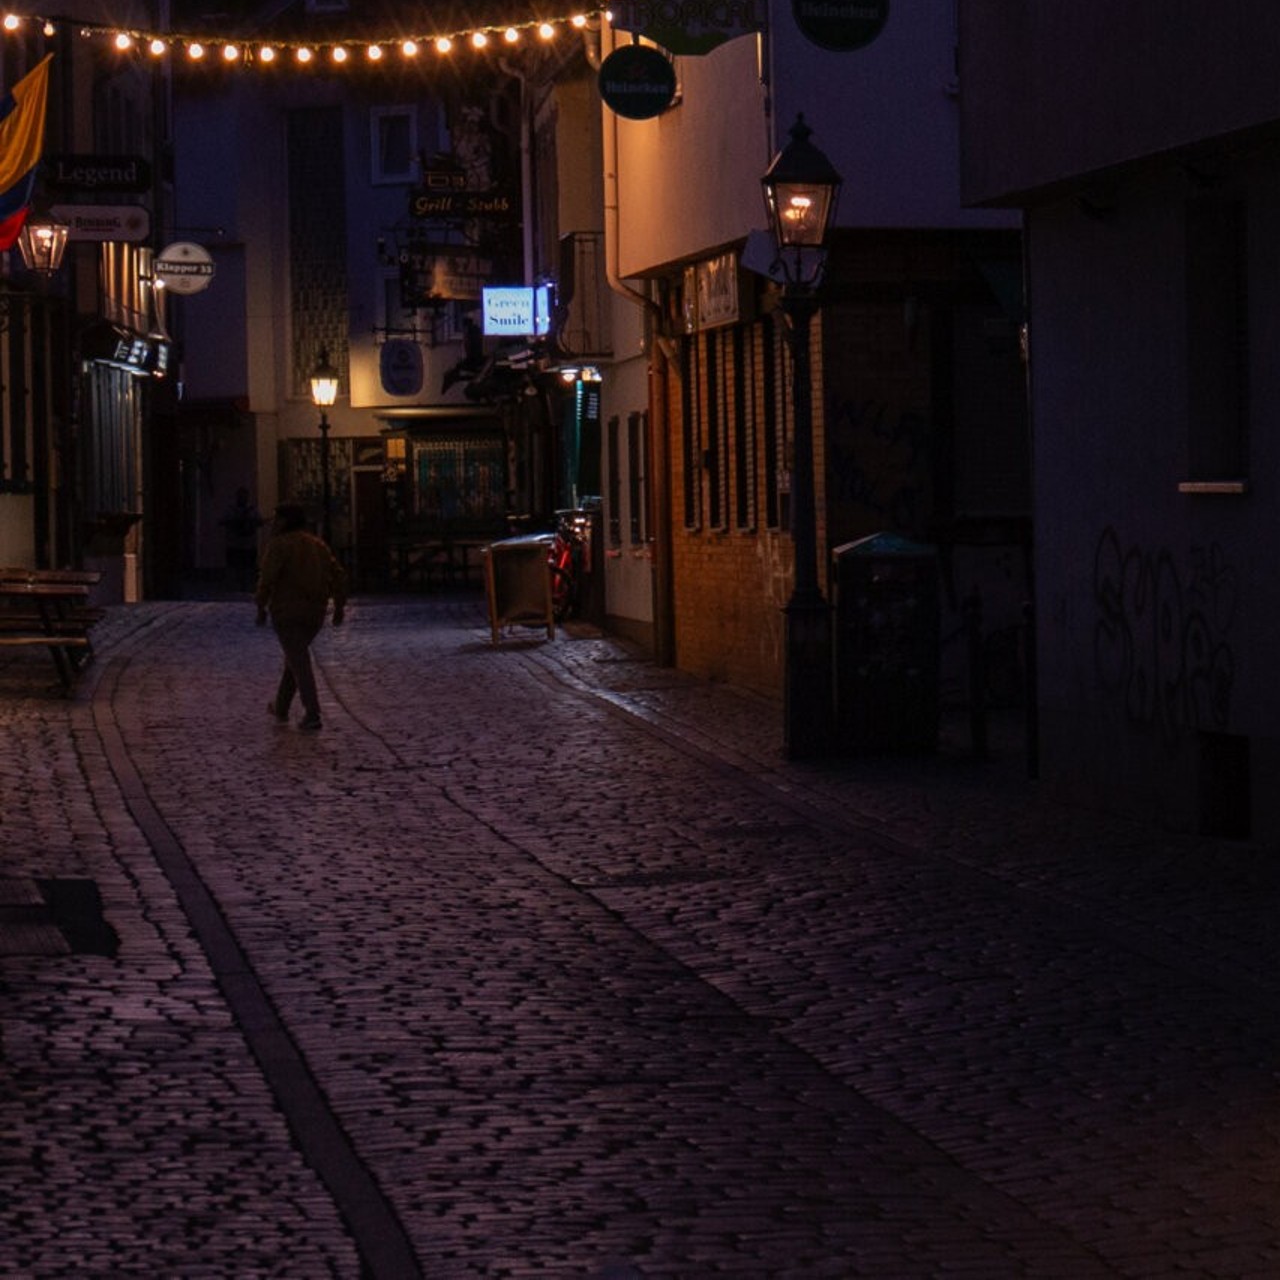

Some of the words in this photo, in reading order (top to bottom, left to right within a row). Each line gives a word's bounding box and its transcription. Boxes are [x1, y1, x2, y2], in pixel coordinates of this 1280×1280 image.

[801, 1, 880, 18] Heineken
[57, 161, 139, 187] Legend
[489, 314, 529, 326] Smile
